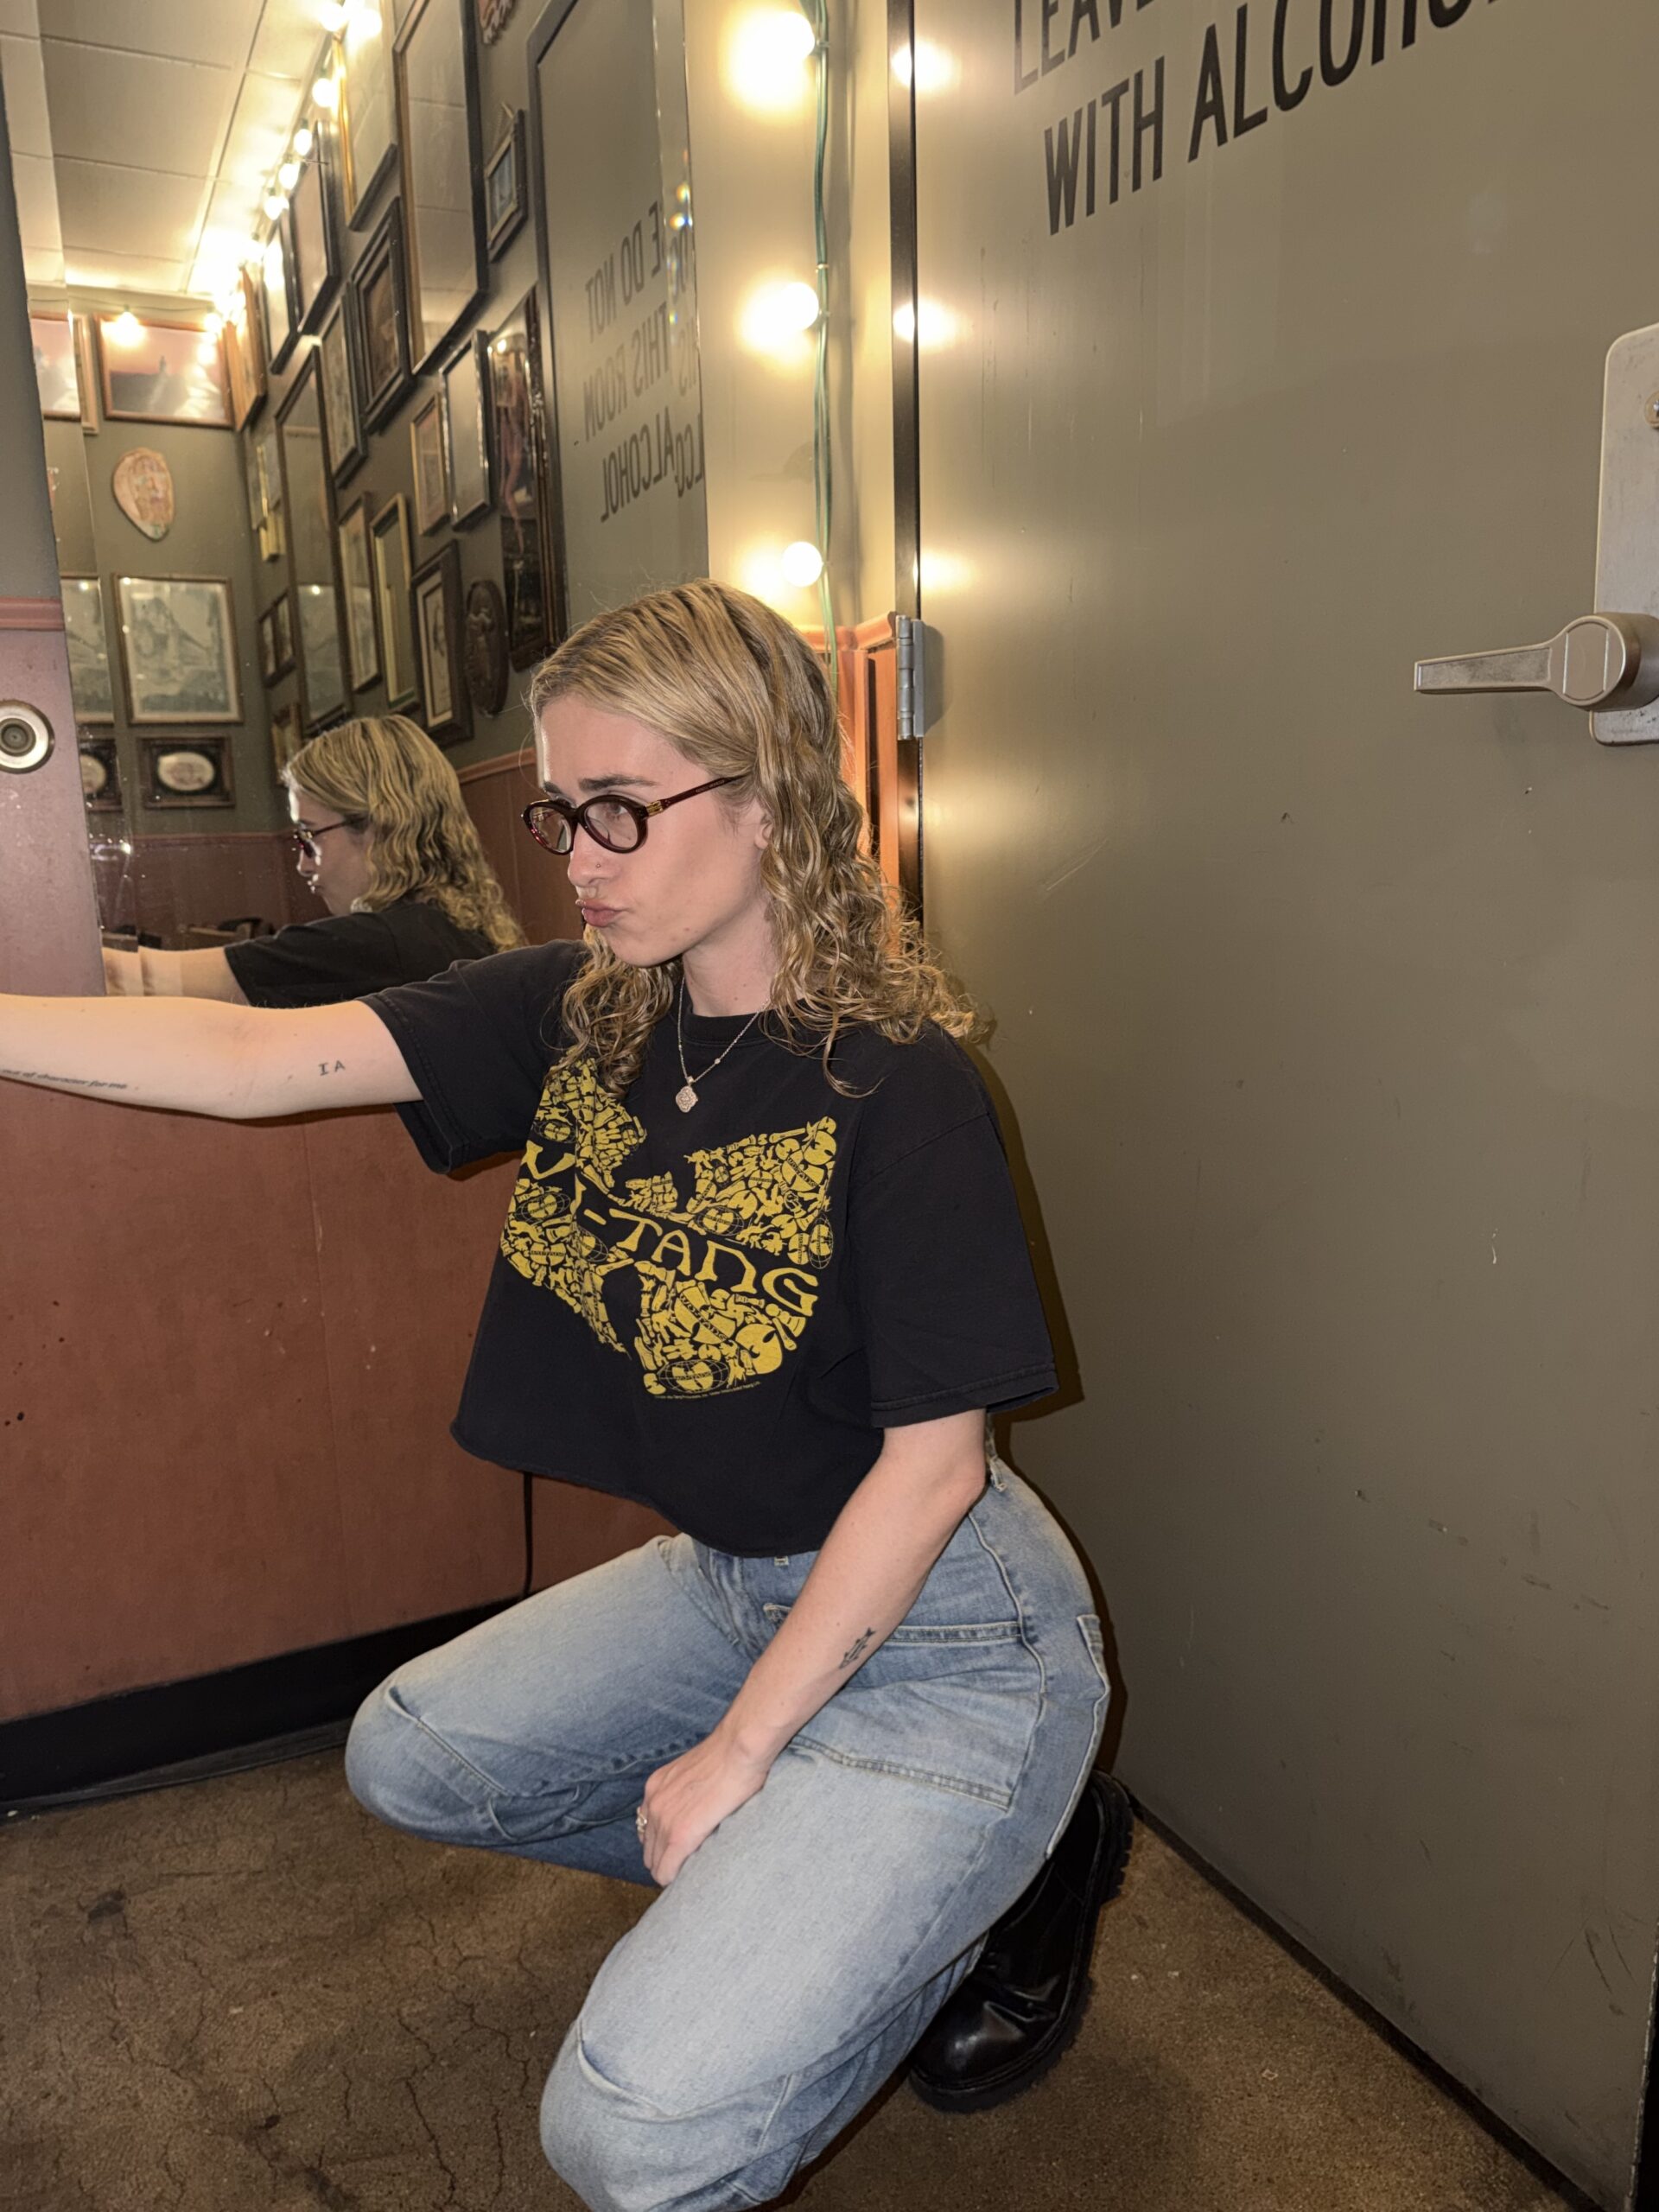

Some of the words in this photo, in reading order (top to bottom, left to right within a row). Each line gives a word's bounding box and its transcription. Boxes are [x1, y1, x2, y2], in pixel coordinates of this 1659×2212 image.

[1014, 0, 1154, 95] LEA
[1043, 55, 1165, 236] WITH
[1188, 0, 1501, 162] ALCO
